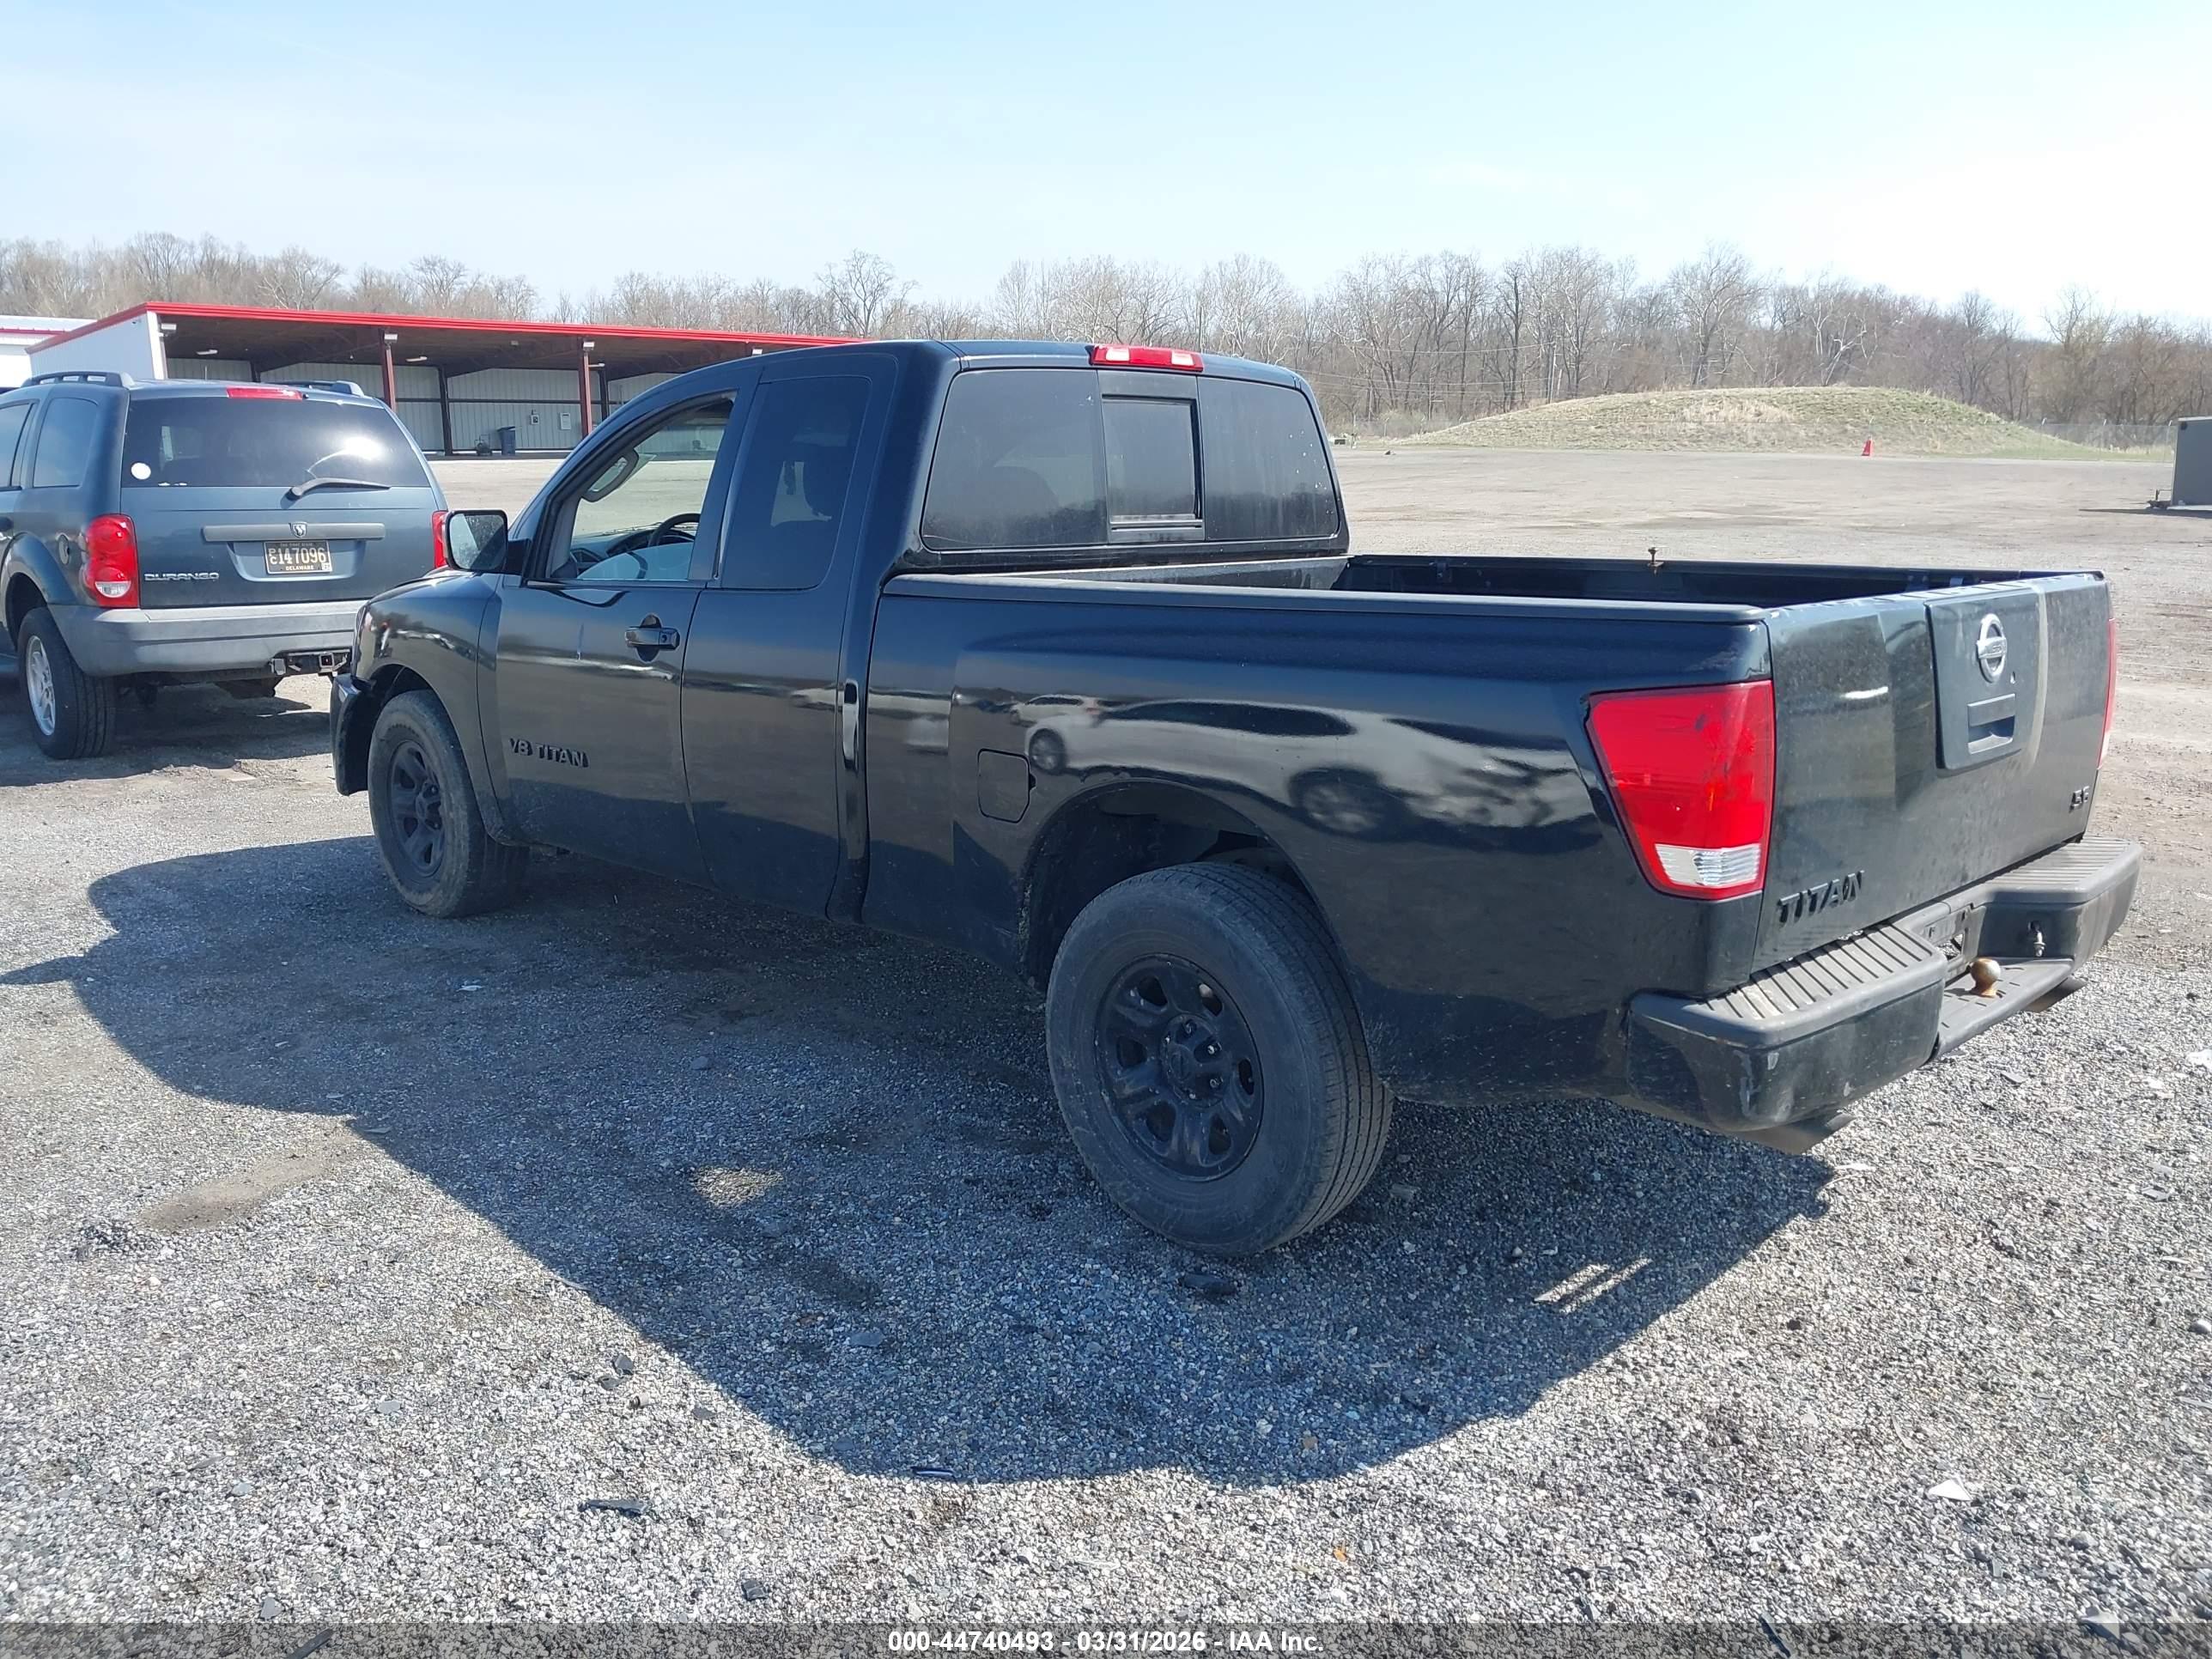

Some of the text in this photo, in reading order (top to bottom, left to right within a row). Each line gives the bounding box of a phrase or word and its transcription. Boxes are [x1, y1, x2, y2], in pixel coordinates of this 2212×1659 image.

[278, 547, 326, 564] 147096
[144, 572, 219, 581] DURANGO
[535, 744, 590, 768] TITAN
[1776, 870, 1865, 926] TITAN
